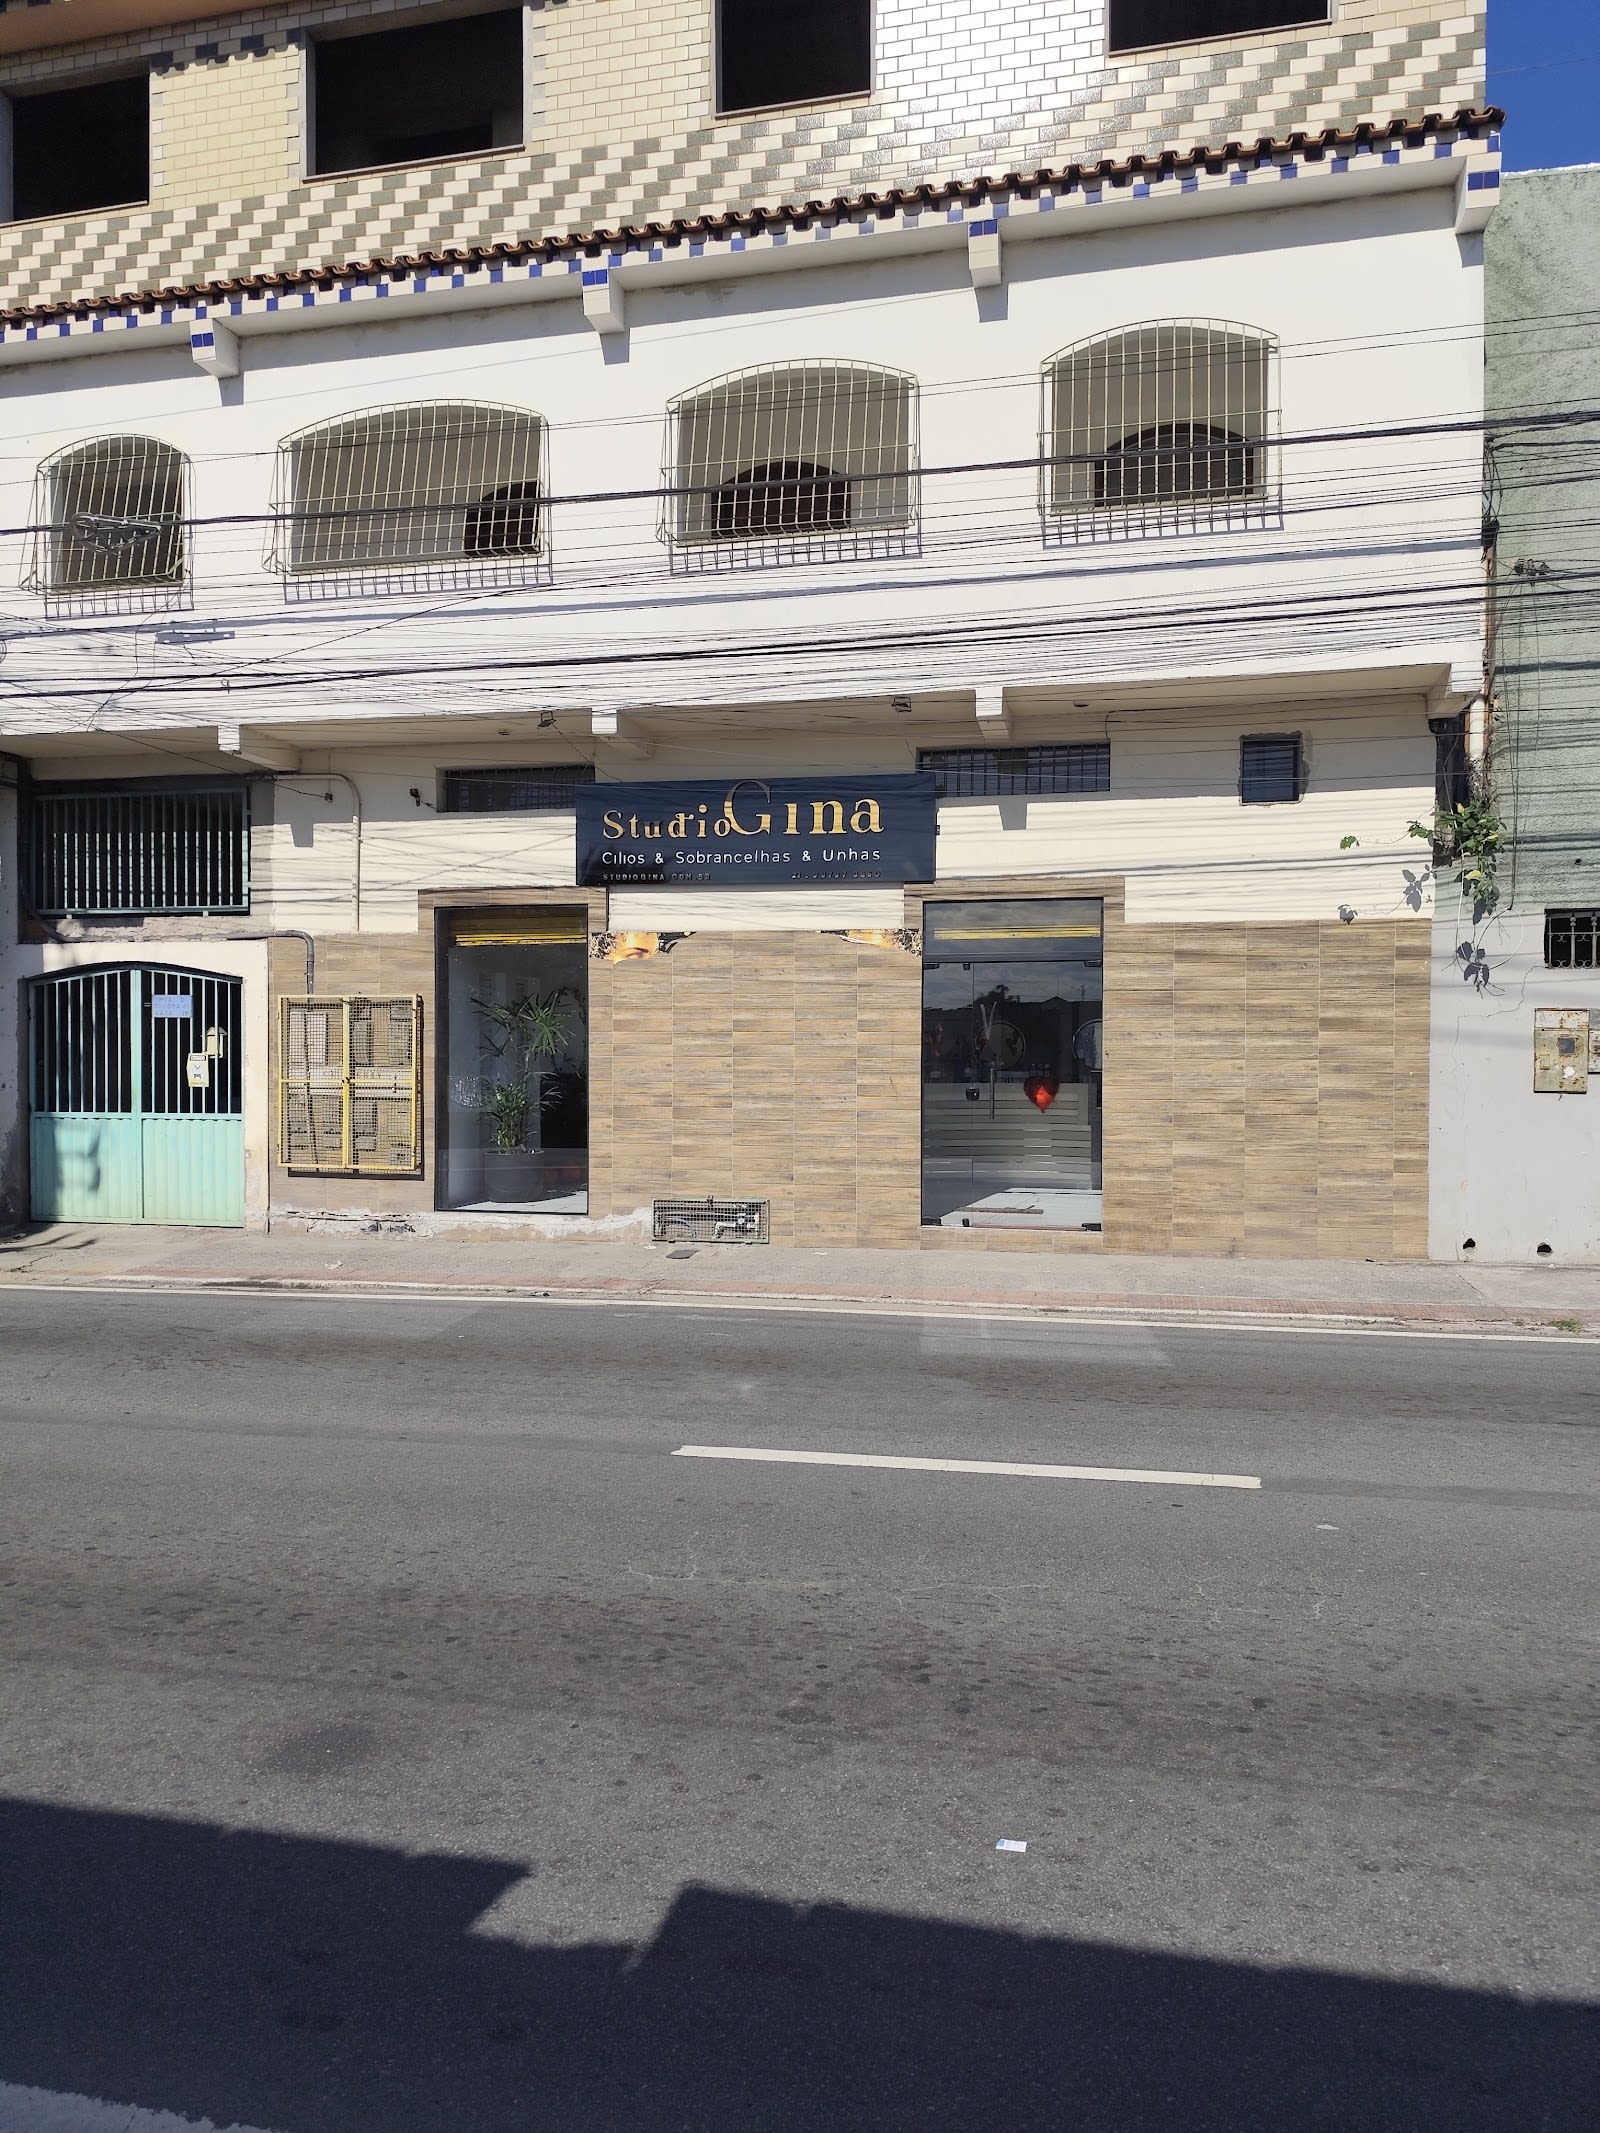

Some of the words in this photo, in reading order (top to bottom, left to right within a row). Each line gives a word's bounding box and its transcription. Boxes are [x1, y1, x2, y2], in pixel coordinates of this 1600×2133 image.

[655, 853, 665, 865] &
[675, 849, 791, 865] Sobrancelhas
[802, 850, 812, 863] &
[822, 847, 881, 863] Unhas
